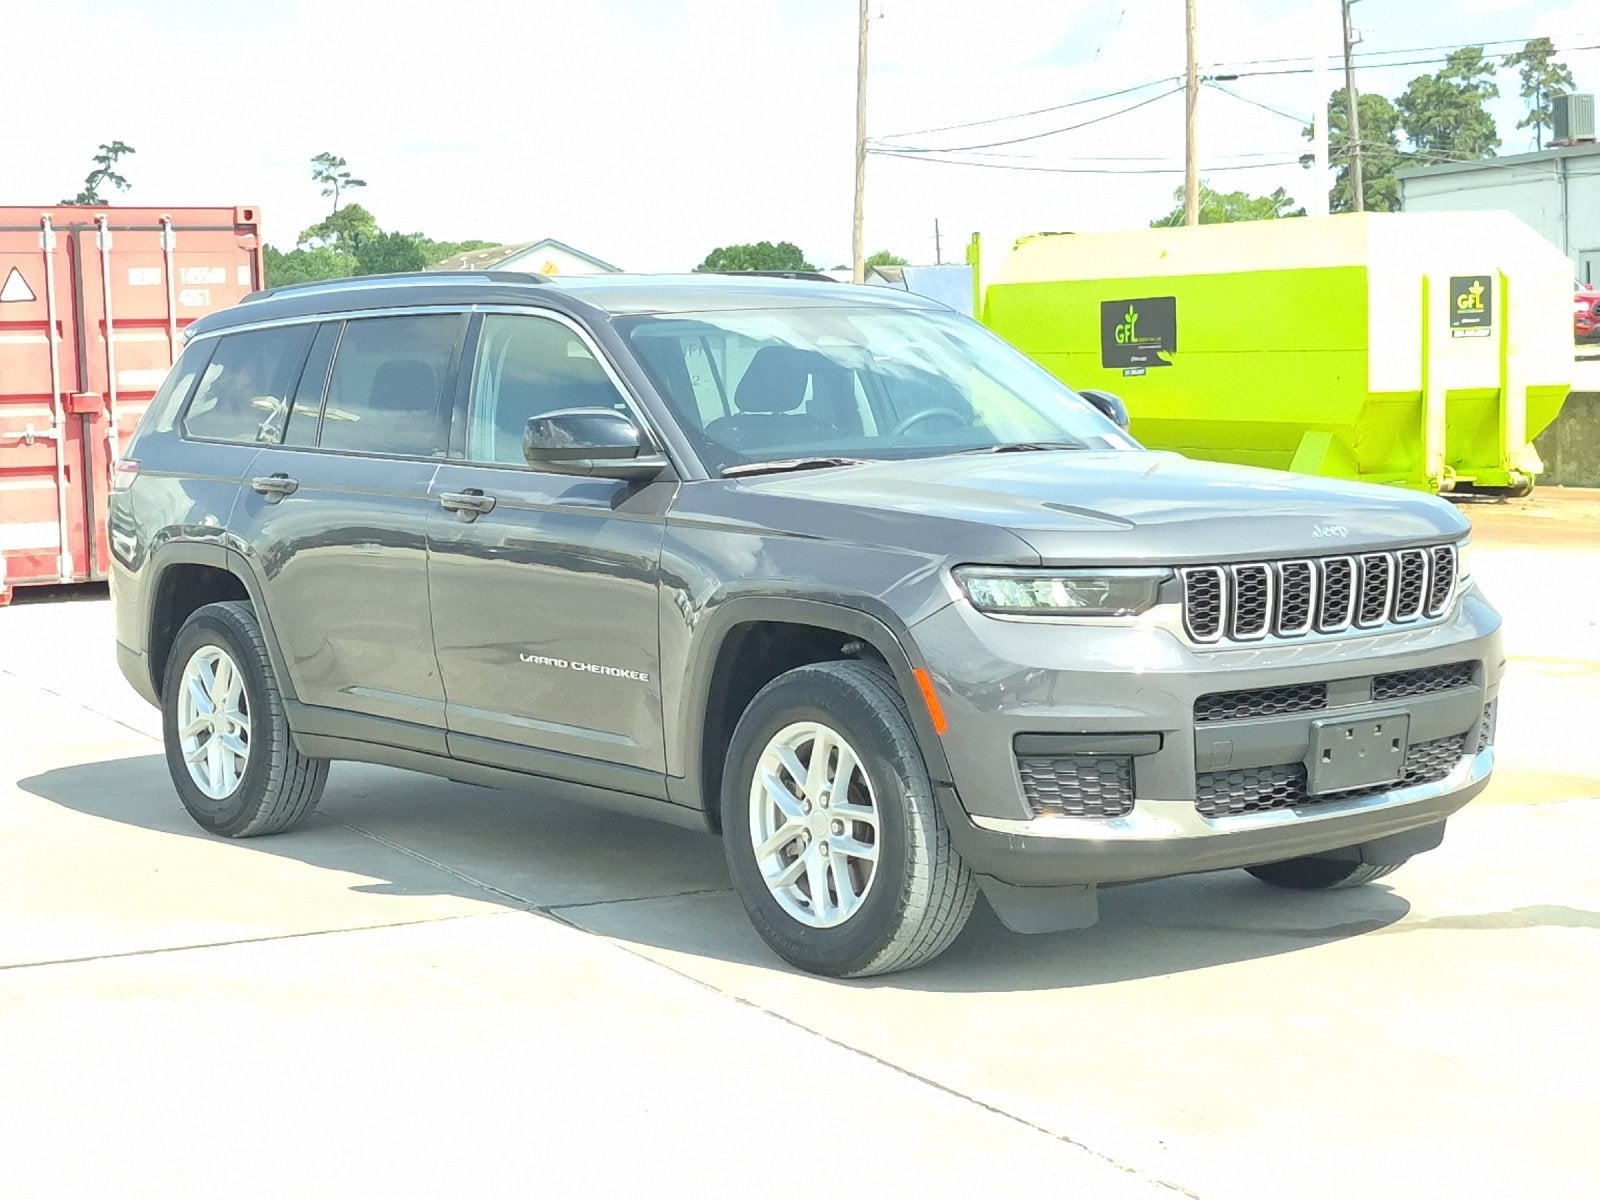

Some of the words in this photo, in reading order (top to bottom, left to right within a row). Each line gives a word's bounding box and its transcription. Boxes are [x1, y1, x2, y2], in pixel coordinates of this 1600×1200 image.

[1457, 287, 1485, 310] GFL
[1115, 313, 1138, 344] GFL
[1312, 524, 1348, 539] Jeep
[519, 653, 569, 669] GRAND
[570, 661, 651, 682] CHEROKEE
